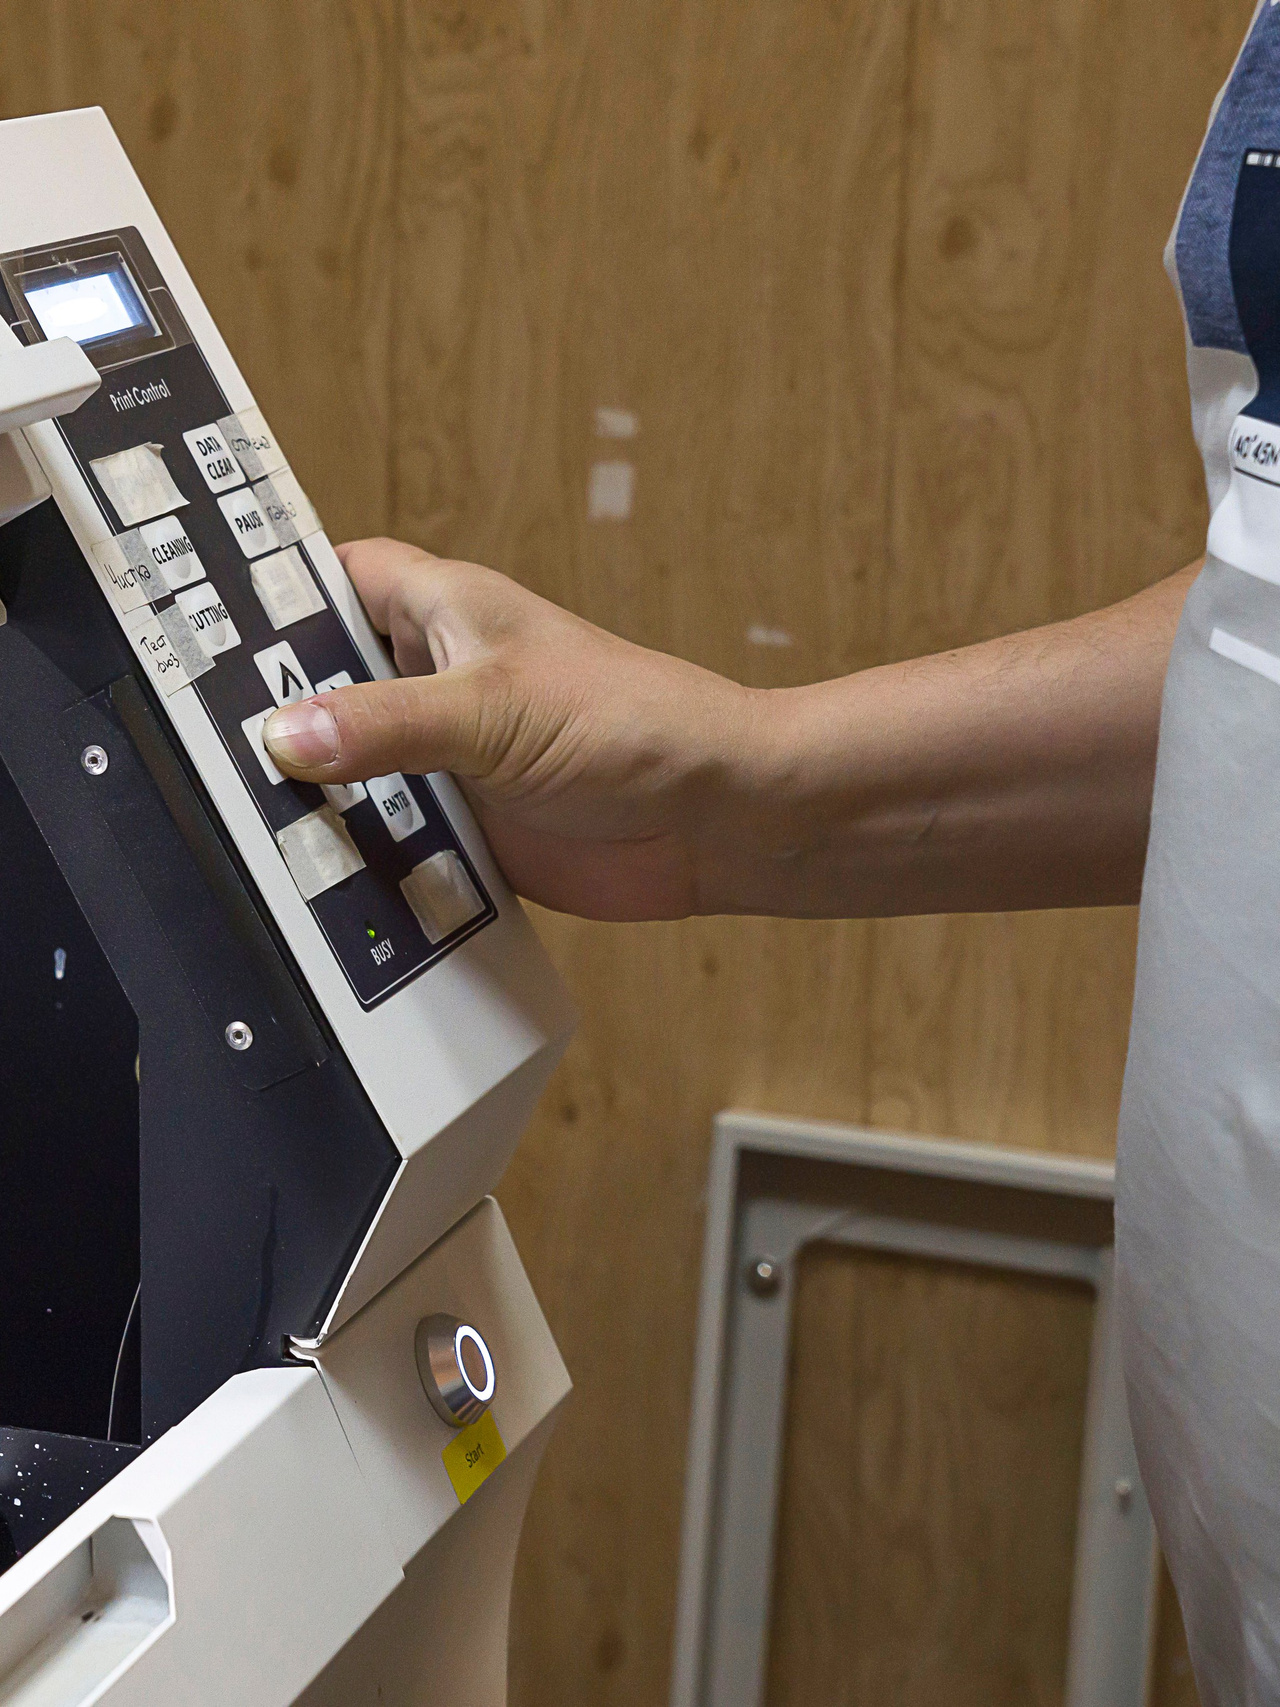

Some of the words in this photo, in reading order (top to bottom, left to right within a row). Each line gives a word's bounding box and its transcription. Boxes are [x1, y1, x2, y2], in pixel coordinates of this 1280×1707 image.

[109, 389, 137, 412] Print
[132, 378, 171, 405] Control
[195, 436, 223, 457] DATA
[206, 457, 236, 480] CLEAR
[151, 535, 194, 565] CLEANING
[370, 938, 395, 966] BUSY
[464, 1443, 485, 1468] Start
